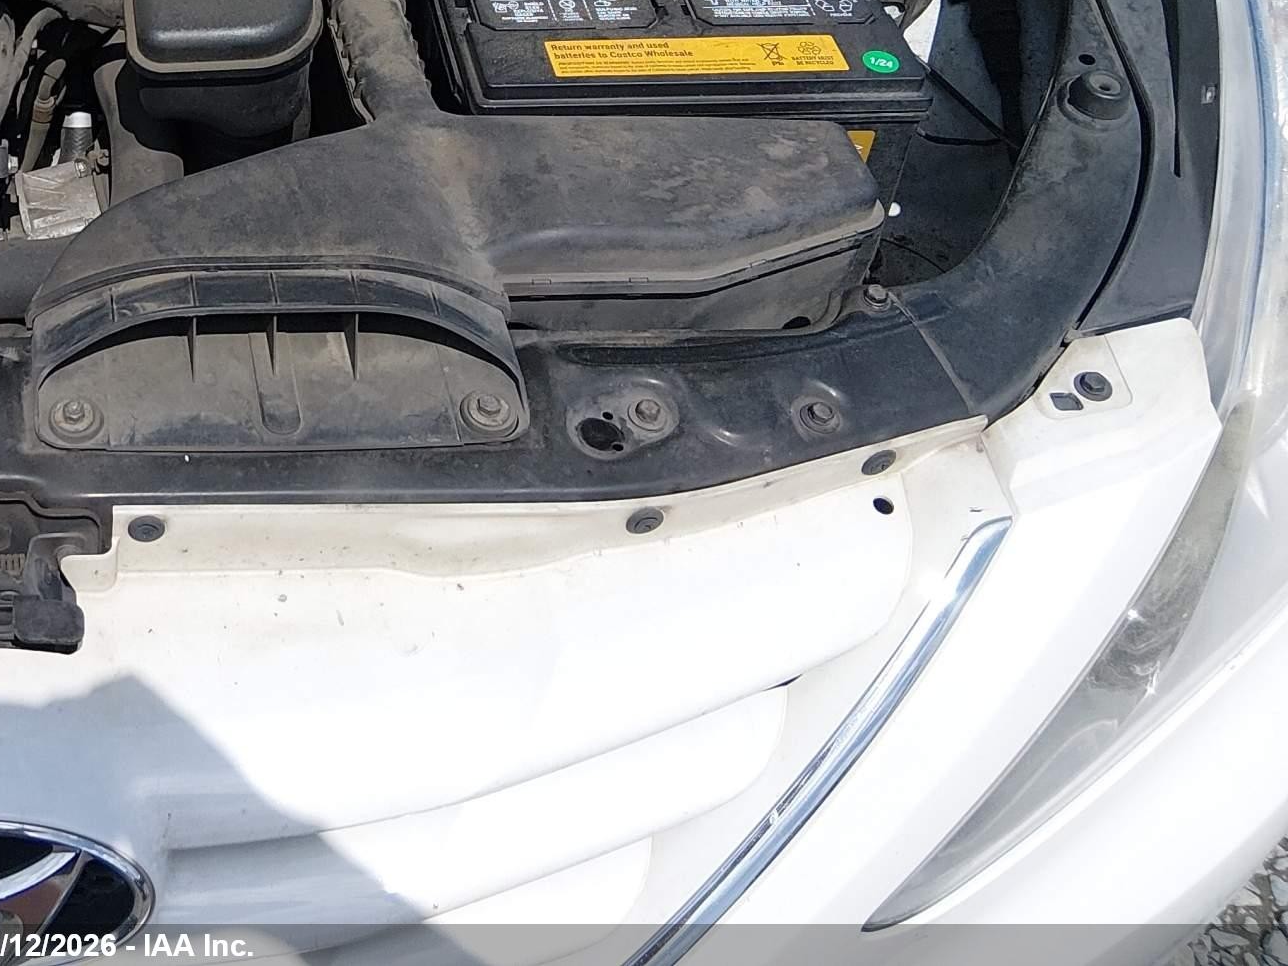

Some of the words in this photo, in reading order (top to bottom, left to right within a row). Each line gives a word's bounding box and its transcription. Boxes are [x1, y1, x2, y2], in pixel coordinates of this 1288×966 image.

[584, 43, 625, 52] warranty
[646, 41, 670, 49] used
[553, 52, 596, 60] batteries
[609, 51, 643, 59] Costco
[645, 50, 694, 58] Wholesale
[869, 56, 893, 68] 1/24
